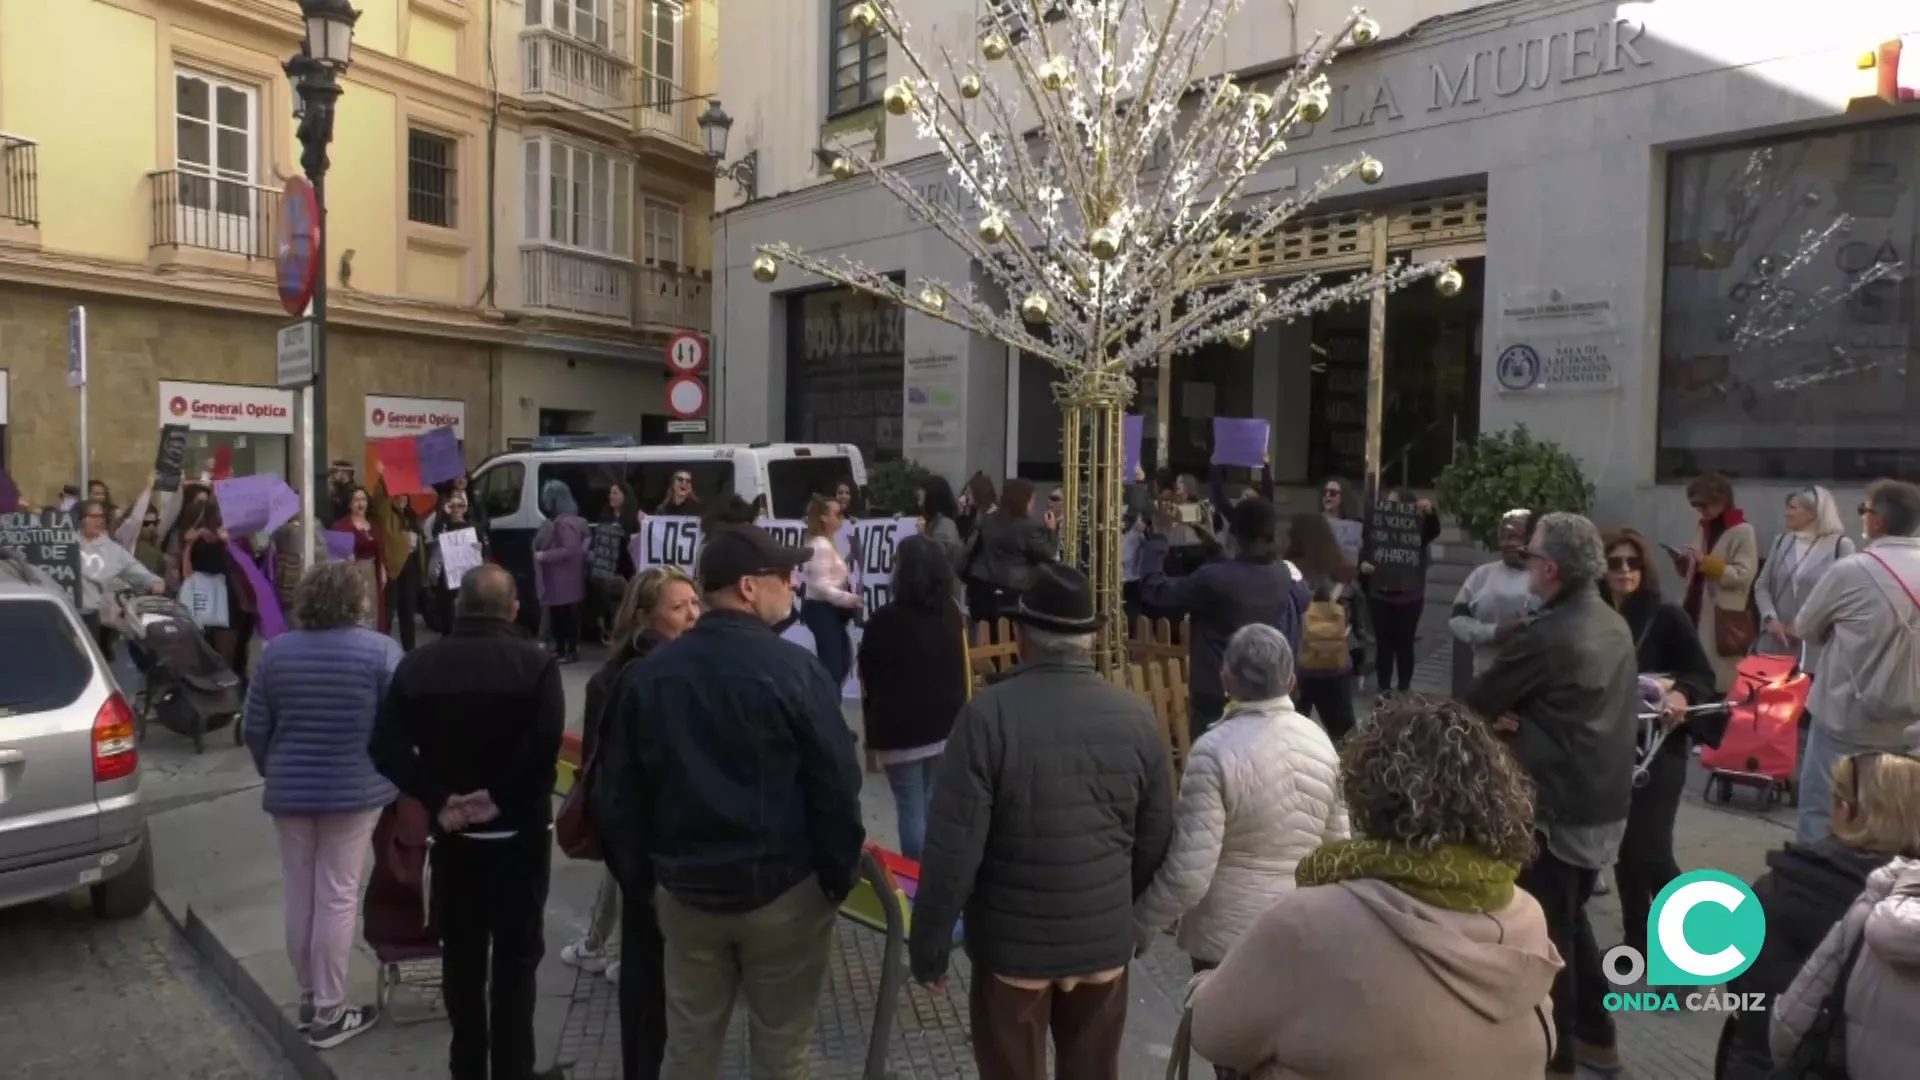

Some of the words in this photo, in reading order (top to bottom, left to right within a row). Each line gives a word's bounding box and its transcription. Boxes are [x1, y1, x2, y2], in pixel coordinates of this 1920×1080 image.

[1331, 75, 1404, 133] LA
[1427, 18, 1652, 112] MUJER
[191, 400, 243, 415] General
[387, 412, 427, 424] General
[51, 511, 73, 529] LA
[647, 521, 698, 565] LOS
[41, 544, 68, 560] DE
